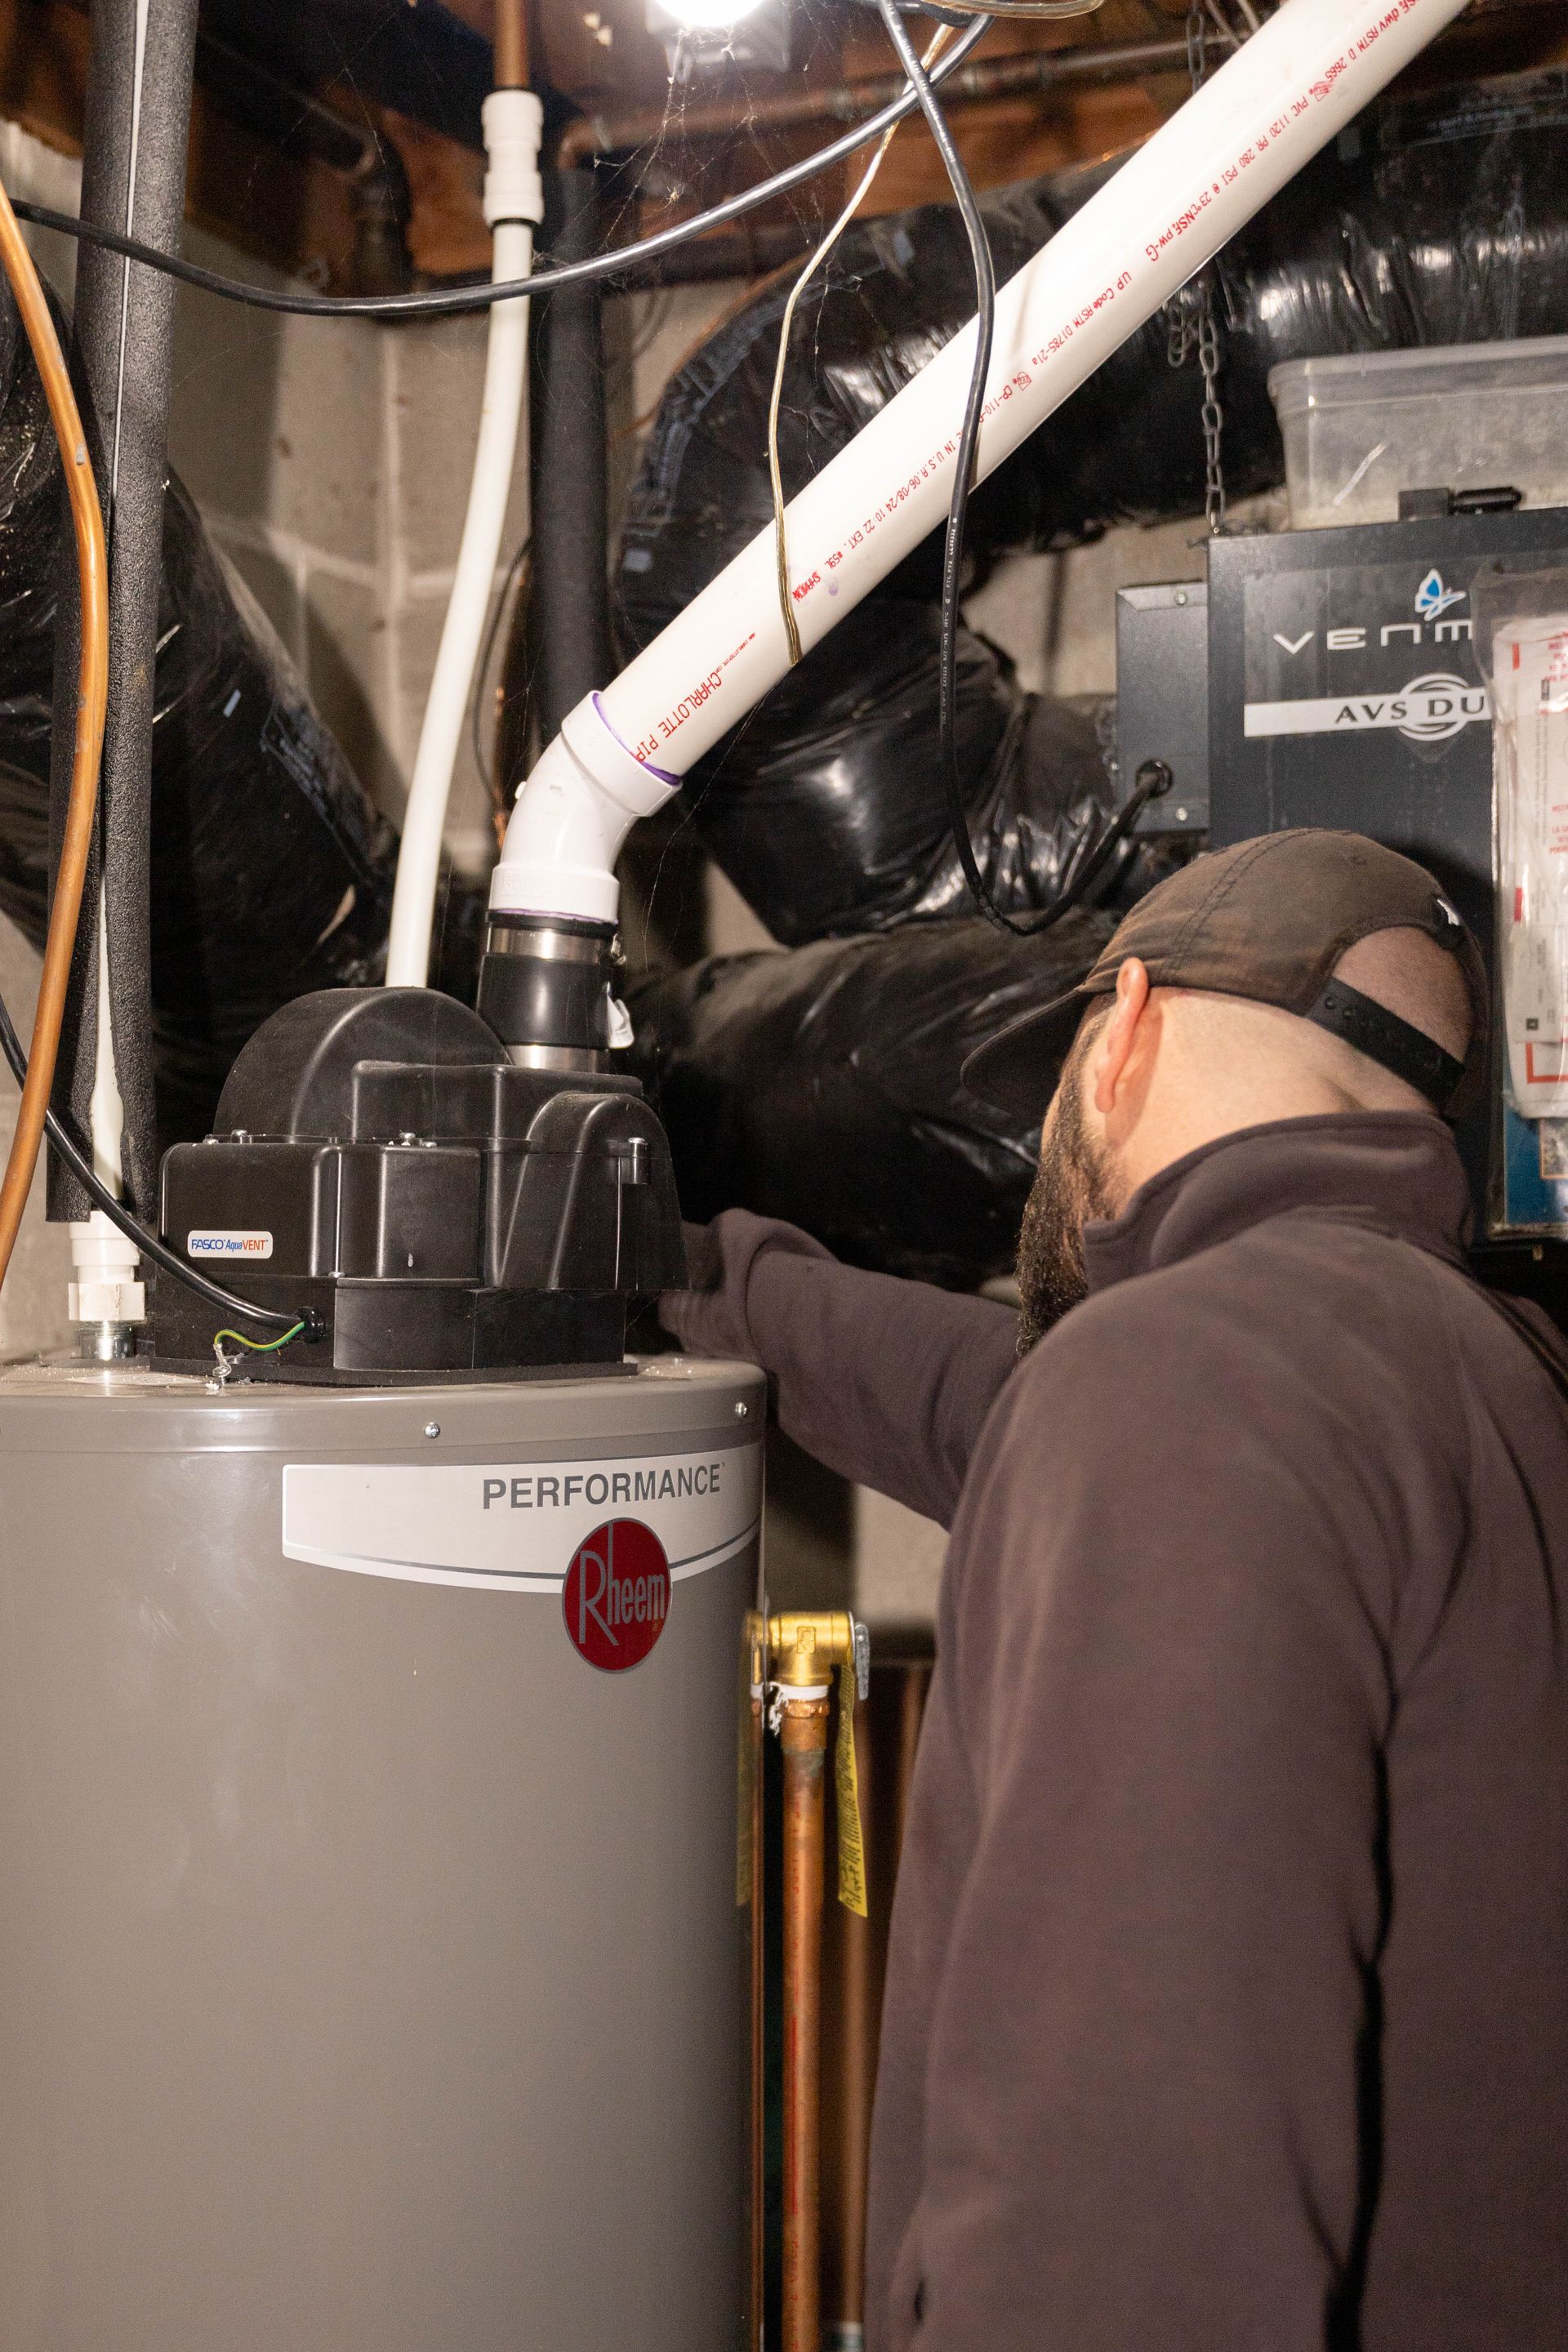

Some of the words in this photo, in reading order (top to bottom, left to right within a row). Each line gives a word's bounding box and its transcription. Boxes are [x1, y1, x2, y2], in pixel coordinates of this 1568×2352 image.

[1379, 7, 1400, 27] dwv
[1356, 26, 1379, 52] ASTM
[1347, 48, 1357, 60] D
[1324, 56, 1348, 82] 2665
[1290, 96, 1309, 117] PVC
[1268, 115, 1291, 139] 1120
[1255, 136, 1269, 152] PR
[1238, 149, 1256, 168] 280
[1222, 167, 1239, 185] PSI
[1093, 287, 1116, 310] Code
[1073, 306, 1094, 328] ASTM
[1032, 327, 1073, 365] D1785-21a
[944, 440, 956, 454] IN
[657, 670, 723, 739] CHARLOTTE
[1334, 702, 1407, 724] AVS
[1428, 695, 1485, 717] DU
[632, 733, 660, 764] PIP
[191, 1239, 224, 1250] FASCO
[483, 1463, 721, 1509] PERFORMANCE
[578, 1523, 666, 1646] Rheem
